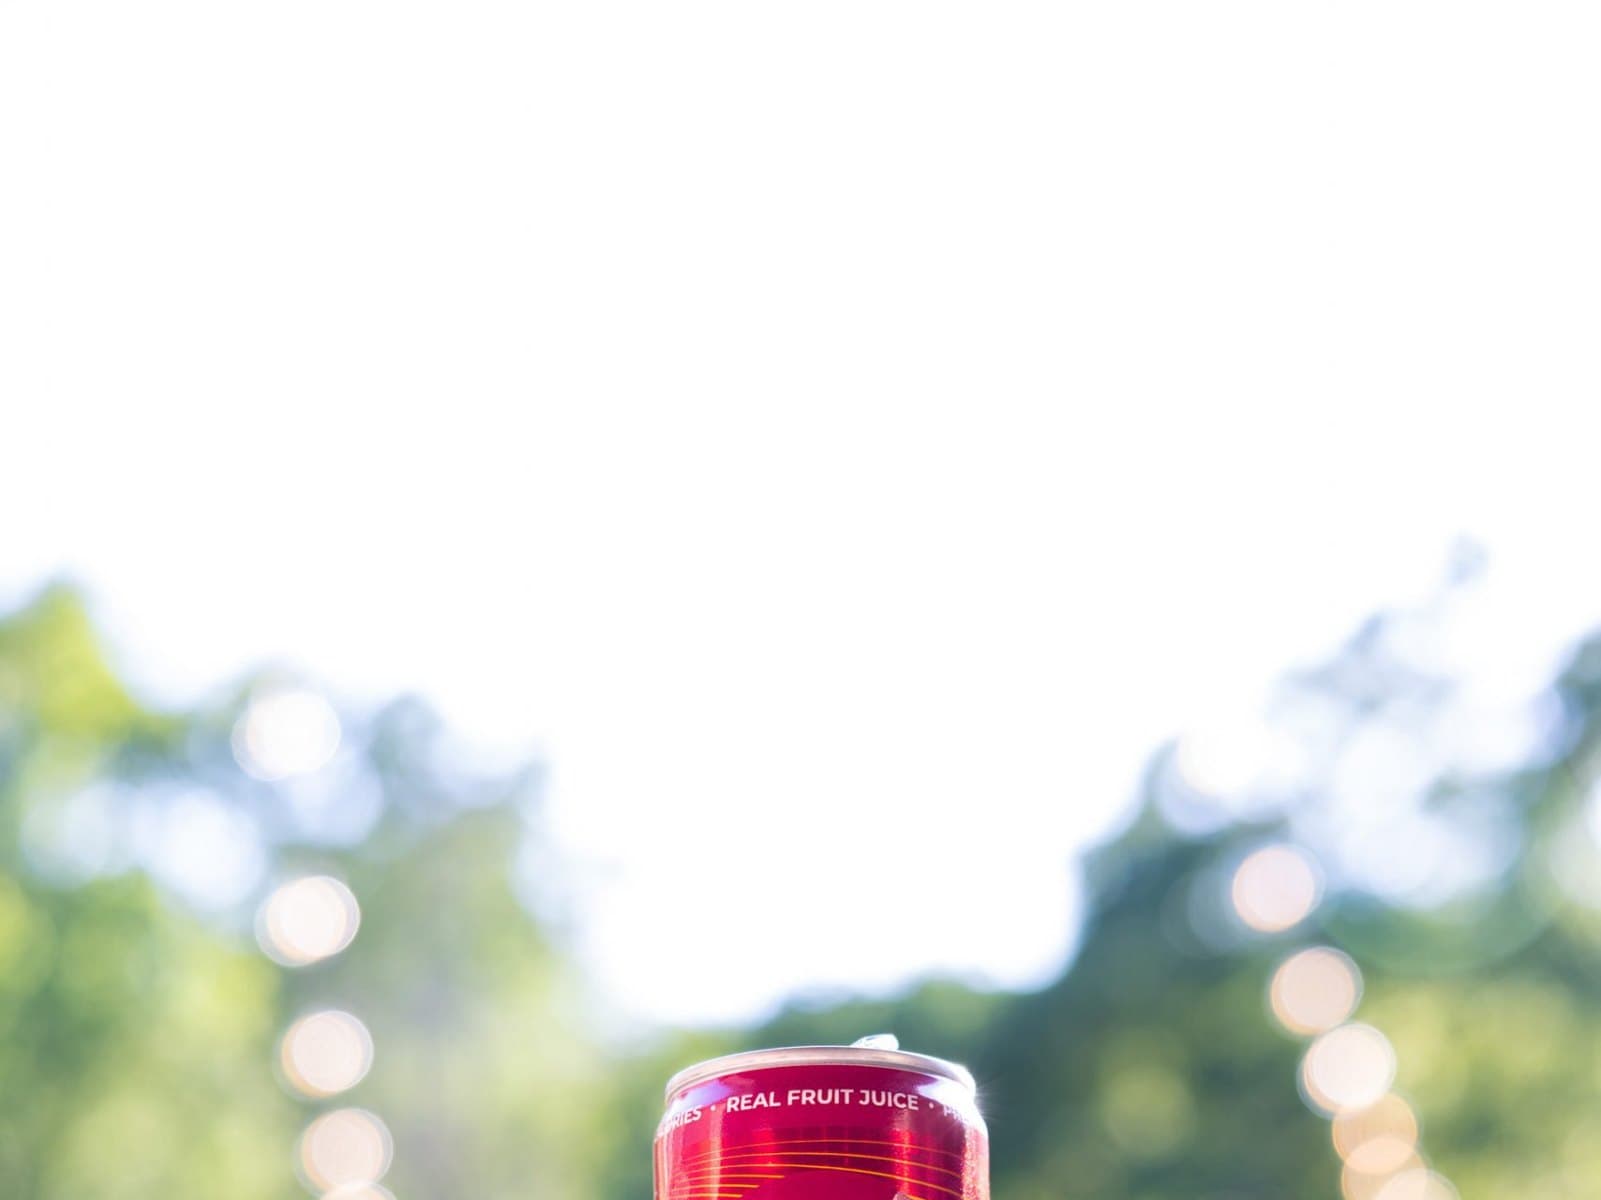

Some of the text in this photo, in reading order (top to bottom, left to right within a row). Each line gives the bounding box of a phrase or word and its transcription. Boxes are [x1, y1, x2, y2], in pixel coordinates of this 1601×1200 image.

[725, 1091, 781, 1113] REAL
[787, 1089, 854, 1106] FRUIT
[859, 1089, 919, 1111] JUICE
